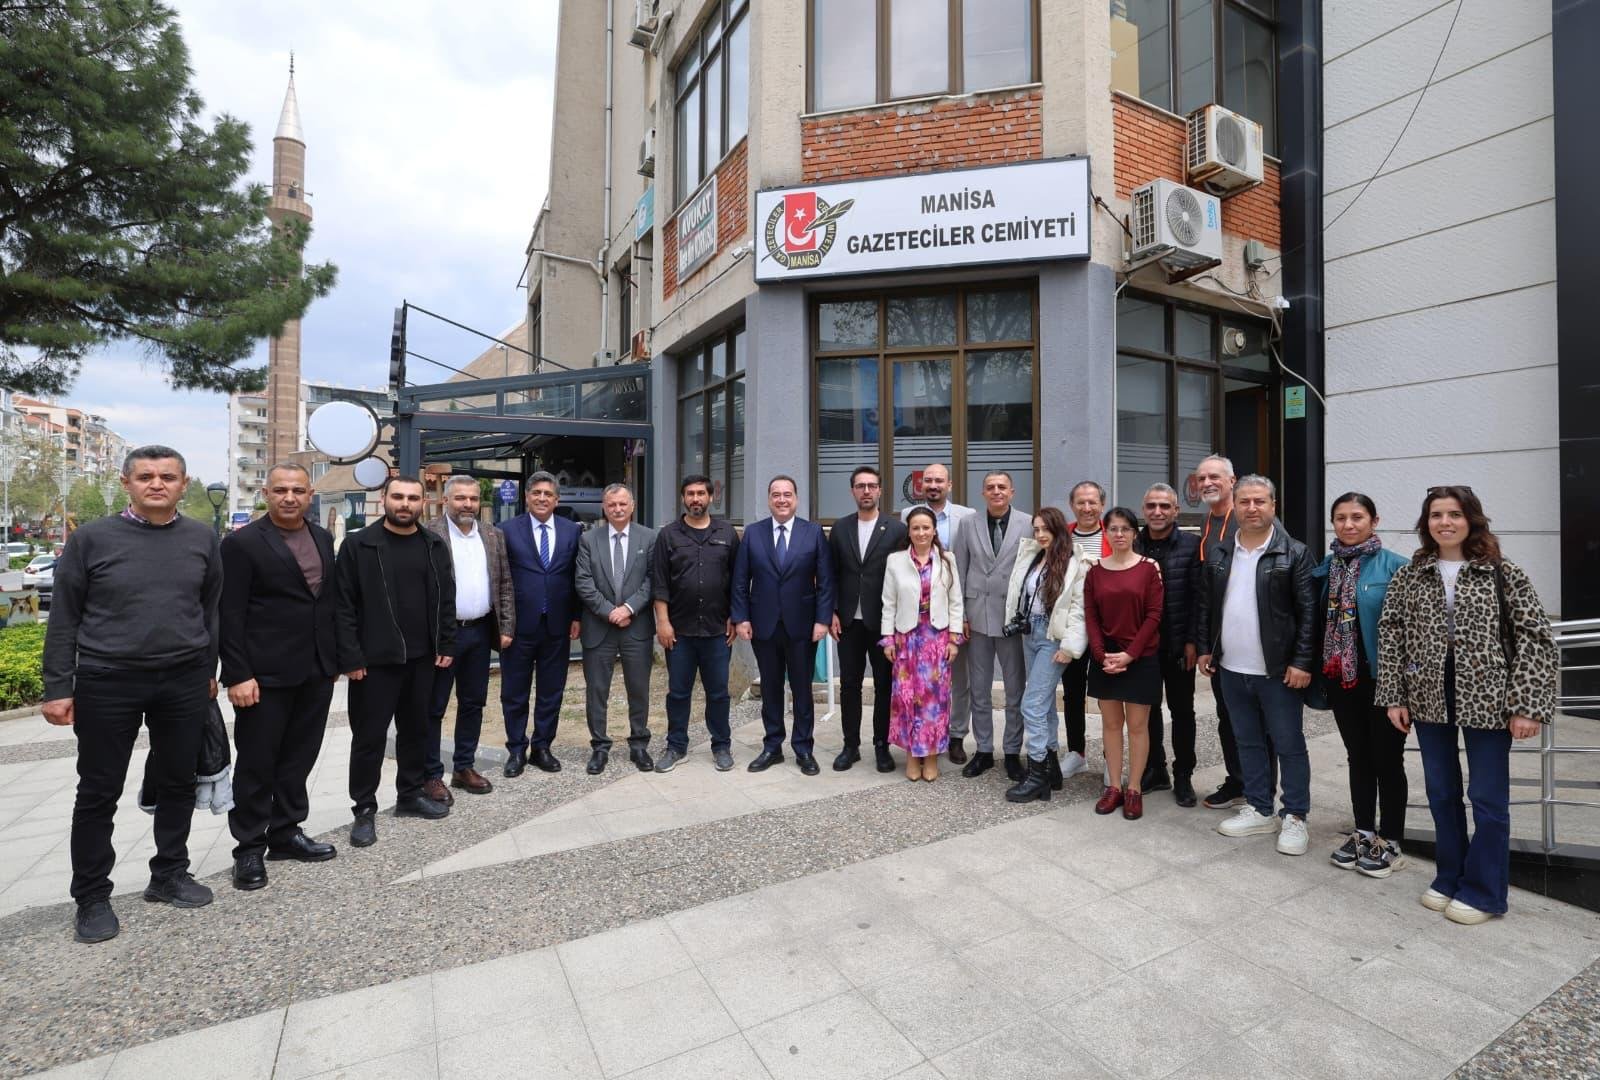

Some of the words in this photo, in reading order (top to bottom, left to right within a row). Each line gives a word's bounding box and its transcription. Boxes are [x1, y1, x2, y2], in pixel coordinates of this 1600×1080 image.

[682, 191, 712, 239] AVUKAT
[921, 187, 996, 214] MANİSA
[847, 223, 975, 254] GAZETECİLER
[981, 212, 1076, 242] CEMİYETİ
[790, 252, 820, 268] MANİSA
